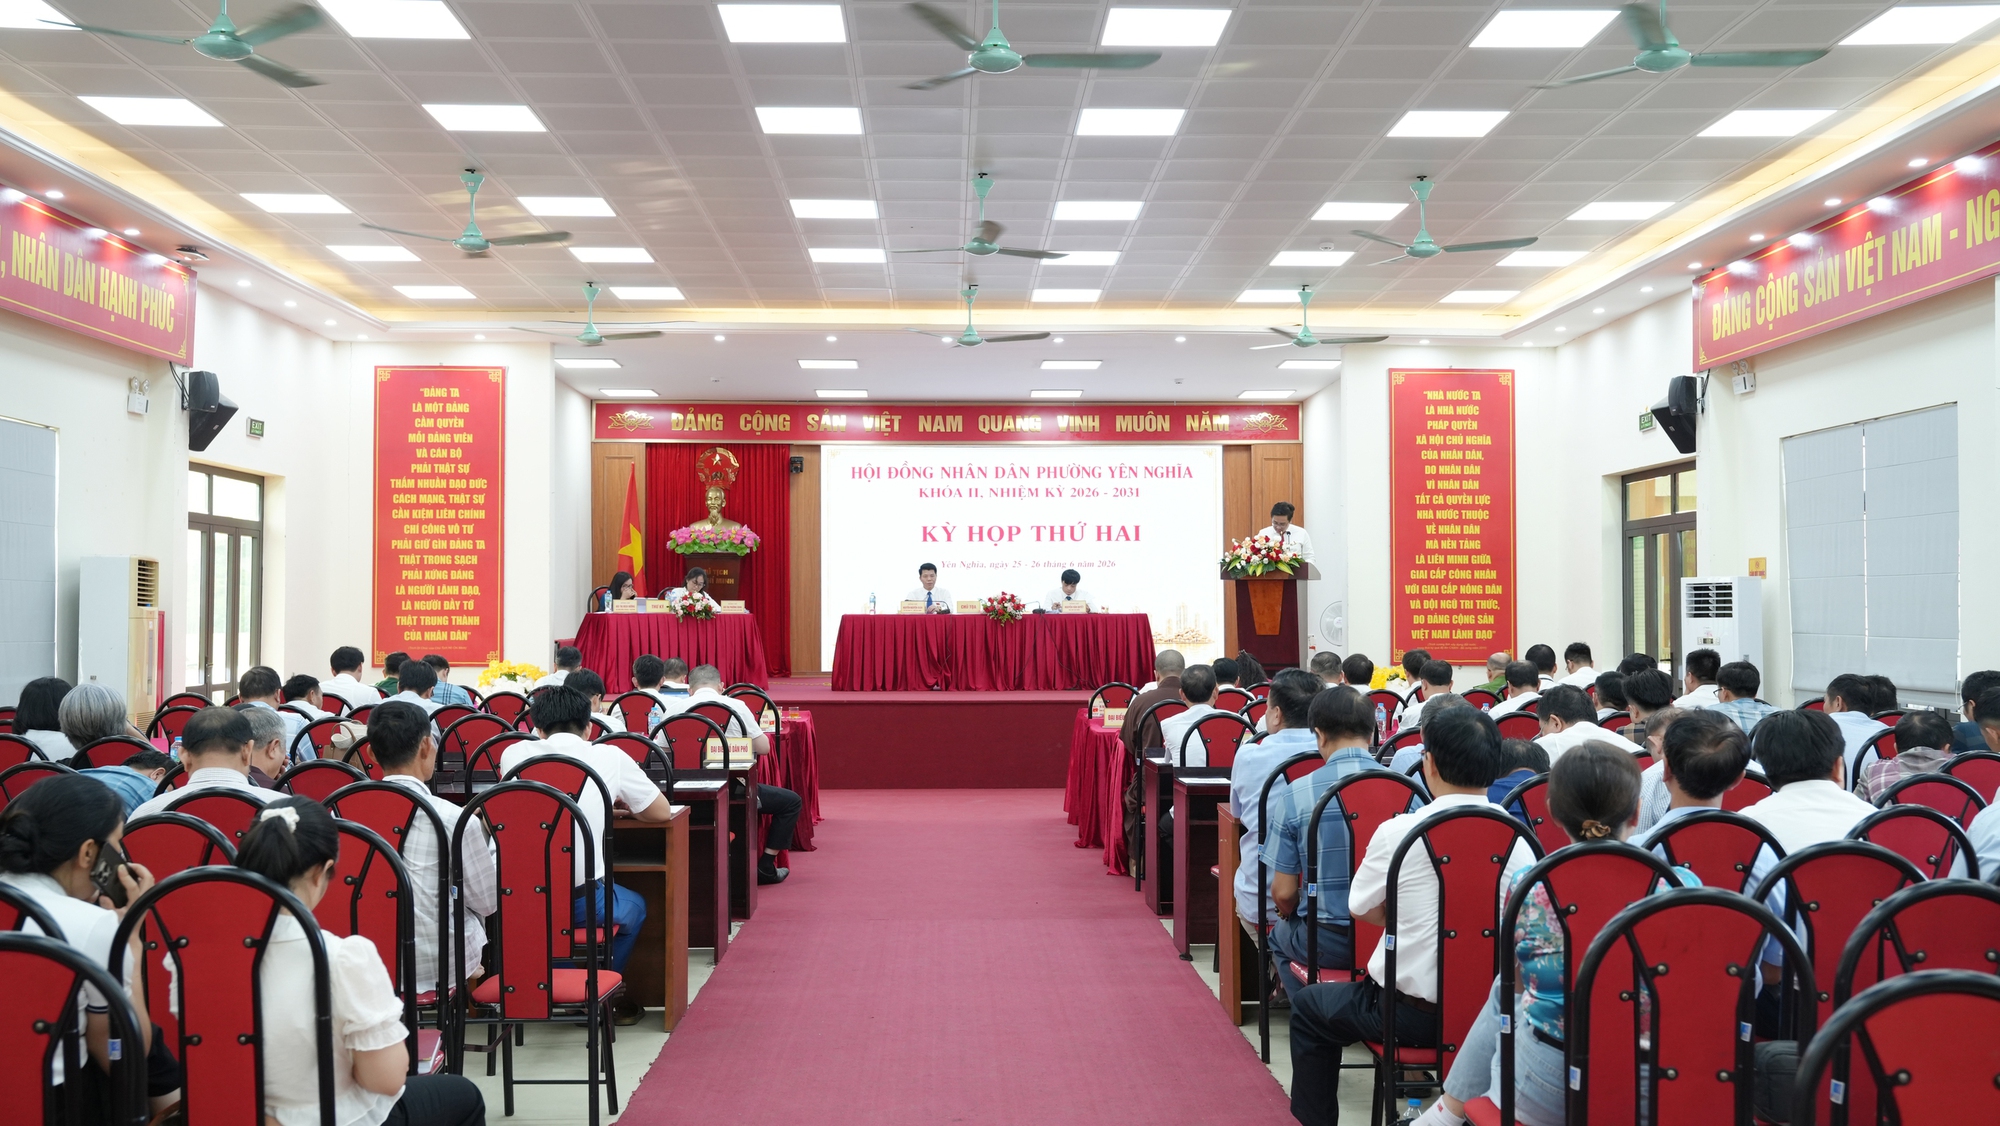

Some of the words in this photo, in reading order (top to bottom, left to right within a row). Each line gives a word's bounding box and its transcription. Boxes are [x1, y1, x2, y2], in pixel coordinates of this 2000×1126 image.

[12, 231, 59, 292] NHÂN
[64, 249, 96, 304] DÂN
[100, 268, 137, 322] HẠNH
[141, 281, 175, 333] PHÚC
[1712, 286, 1751, 341] ĐẢNG
[1755, 273, 1798, 330] CỘNG
[1804, 246, 1839, 308] SẢN
[1846, 232, 1886, 296] VIỆT
[1892, 212, 1942, 276] NAM
[1950, 228, 1958, 240] -
[450, 388, 459, 397] TA
[1472, 391, 1481, 400] TA
[413, 402, 422, 412] LÀ
[425, 402, 444, 414] MỘT
[446, 402, 469, 412] ĐẢNG
[1426, 405, 1435, 414] LÀ
[1437, 405, 1454, 414] NHÀ
[252, 421, 262, 429] EXIT
[671, 408, 723, 431] ĐẢNG
[740, 410, 791, 436] CỘNG
[806, 408, 846, 432] SẢN
[863, 411, 902, 436] VIỆT
[919, 415, 963, 432] NAM
[979, 415, 1042, 434] QUANG
[1057, 415, 1100, 432] VINH
[1116, 411, 1170, 432] MUÔN
[1186, 411, 1229, 432] NĂM
[1428, 420, 1449, 429] PHÁP
[1641, 415, 1651, 424] EXIT
[428, 432, 451, 442] ĐẢNG
[454, 432, 472, 443] VIÊN
[1416, 434, 1427, 444] XÃ
[1429, 434, 1443, 446] HỘI
[1446, 434, 1463, 444] CHỦ
[1466, 435, 1491, 444] NGHĨA
[416, 448, 428, 458] VÀ
[430, 448, 447, 458] CÁN
[450, 448, 462, 459] BỘ
[1422, 449, 1438, 459] CỦA
[1441, 449, 1463, 459] NHÂN
[411, 462, 431, 473] PHẢI
[434, 462, 455, 474] THẬT
[458, 463, 470, 474] SỰ
[851, 463, 881, 482] HỘI
[888, 461, 933, 479] ĐỒNG
[941, 463, 988, 479] NHÂN
[994, 463, 1029, 479] DÂN
[1037, 463, 1102, 478] PHƯỜNG
[1108, 463, 1138, 478] YÊN
[1144, 464, 1193, 478] NGHĨA
[1425, 465, 1436, 474] DO
[1439, 464, 1461, 474] NHÂN
[1464, 464, 1480, 474] DÂN
[449, 479, 466, 490] ĐẠO
[1426, 479, 1435, 489] VÌ
[1438, 479, 1460, 489] NHÂN
[1462, 479, 1479, 489] DÂN
[919, 485, 963, 498] KHÓA
[990, 485, 1039, 500] NHIỆM
[1045, 485, 1065, 497] KỲ
[1070, 488, 1099, 497] 2026
[1113, 488, 1140, 497] 2031
[393, 493, 416, 503] CÁCH
[449, 493, 470, 505] THẬT
[473, 494, 485, 505] SỰ
[412, 508, 433, 520] KIỆM
[436, 508, 455, 518] LIÊM
[458, 509, 485, 519] CHÍNH
[1417, 509, 1434, 519] NHÀ
[1461, 509, 1489, 520] THUỘC
[404, 524, 419, 534] CHÍ
[422, 523, 445, 534] CÔNG
[448, 524, 460, 534] VÔ
[462, 524, 474, 534] TƯ
[922, 522, 957, 542] KỲ
[968, 526, 1021, 546] HỌP
[1031, 521, 1087, 542] THỨ
[1096, 525, 1141, 542] HAI
[1439, 524, 1461, 534] NHÂN
[1464, 524, 1480, 534] DÂN
[1426, 539, 1439, 549] MÀ
[1459, 538, 1480, 549] TẢNG
[399, 554, 421, 566] THẬT
[423, 555, 452, 564] TRONG
[454, 555, 477, 566] SẠCH
[1411, 570, 1427, 579] GIAI
[1449, 569, 1471, 579] CÔNG
[1474, 569, 1496, 579] NHÂN
[396, 585, 405, 594] LÀ
[438, 584, 459, 594] LÃNH
[1422, 585, 1438, 594] GIAI
[1460, 584, 1482, 594] NÔNG
[1486, 584, 1502, 594] DÂN
[396, 615, 418, 627] THẬT
[420, 616, 448, 625] TRUNG
[451, 615, 479, 625] THÀNH
[1414, 615, 1424, 624] DO
[1427, 613, 1450, 624] ĐẢNG
[1452, 614, 1475, 625] CỘNG
[1478, 613, 1494, 624] SẢN
[404, 630, 422, 640] CỦA
[424, 630, 447, 640] NHÂN
[1412, 629, 1429, 640] VIỆT
[1432, 630, 1450, 638] NAM
[1452, 629, 1473, 639] LÃNH
